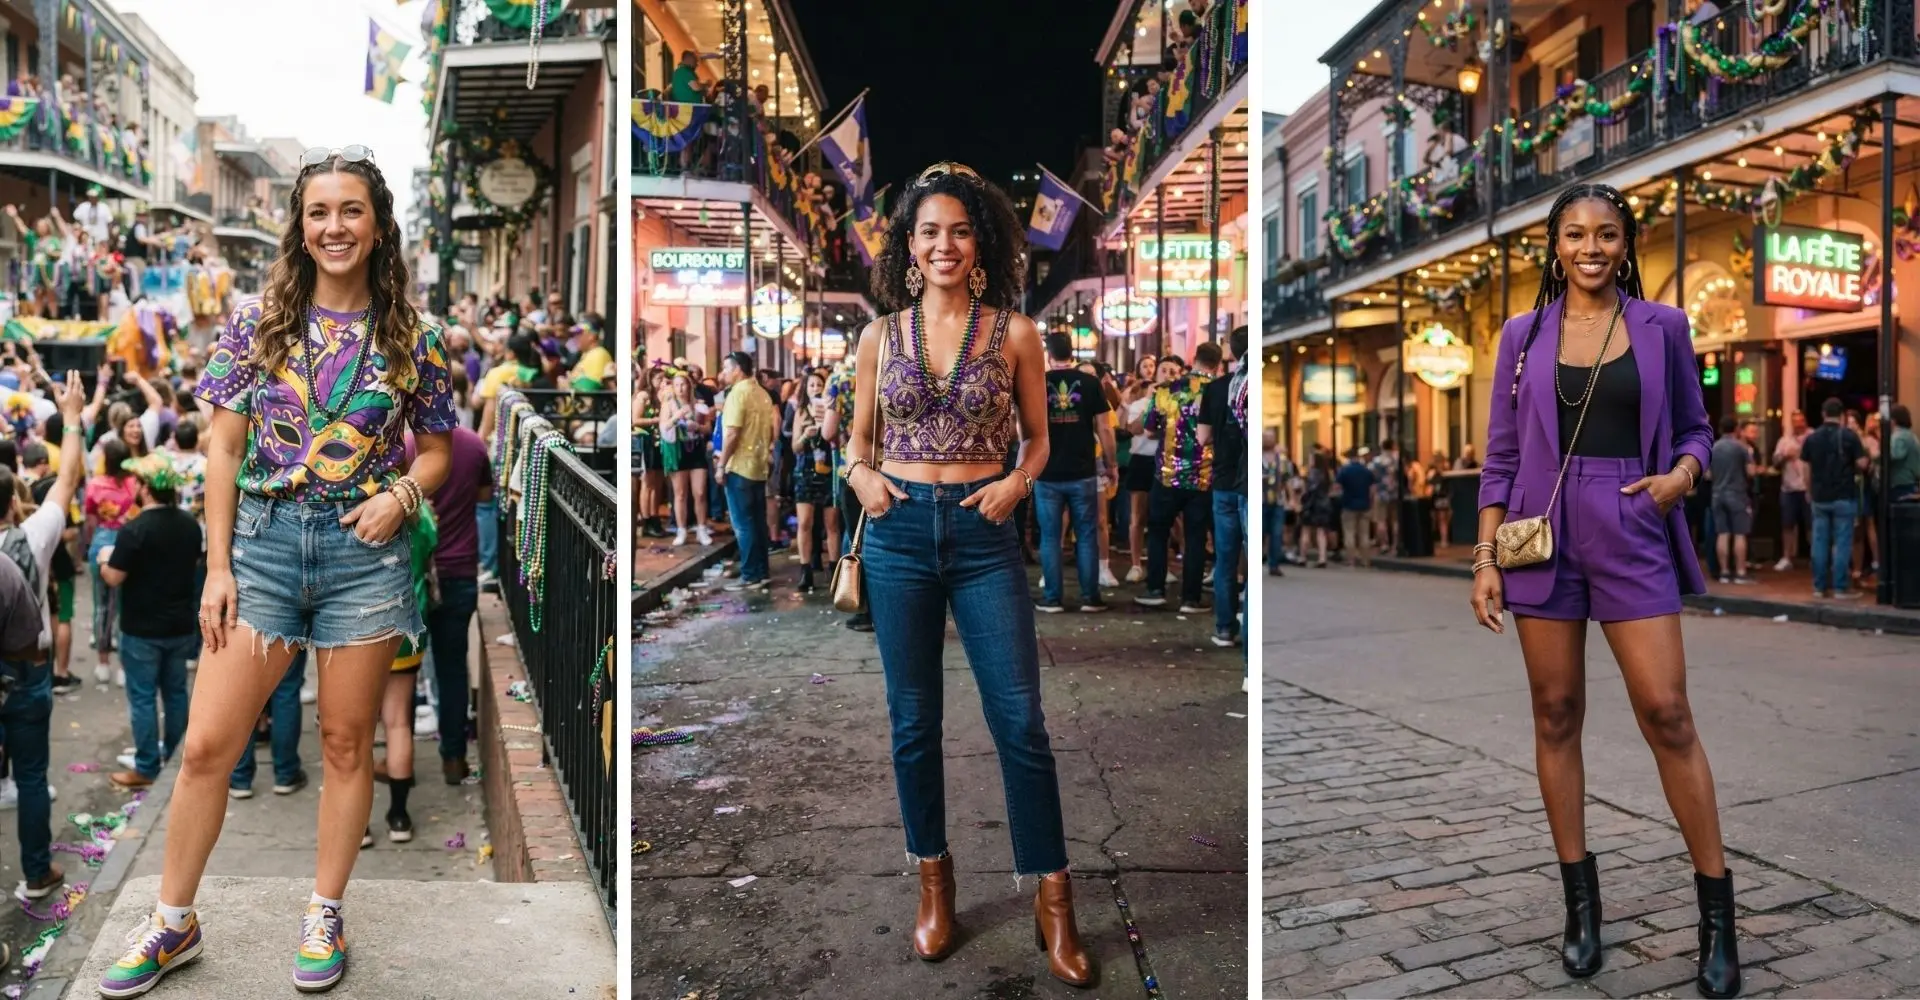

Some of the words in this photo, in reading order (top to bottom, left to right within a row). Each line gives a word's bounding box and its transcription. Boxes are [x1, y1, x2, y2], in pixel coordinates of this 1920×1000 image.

[652, 252, 723, 268] BOURBON
[725, 252, 745, 268] ST
[1772, 233, 1801, 262] LA
[1805, 234, 1861, 272] FÊTE
[1772, 265, 1861, 302] ROYALE
